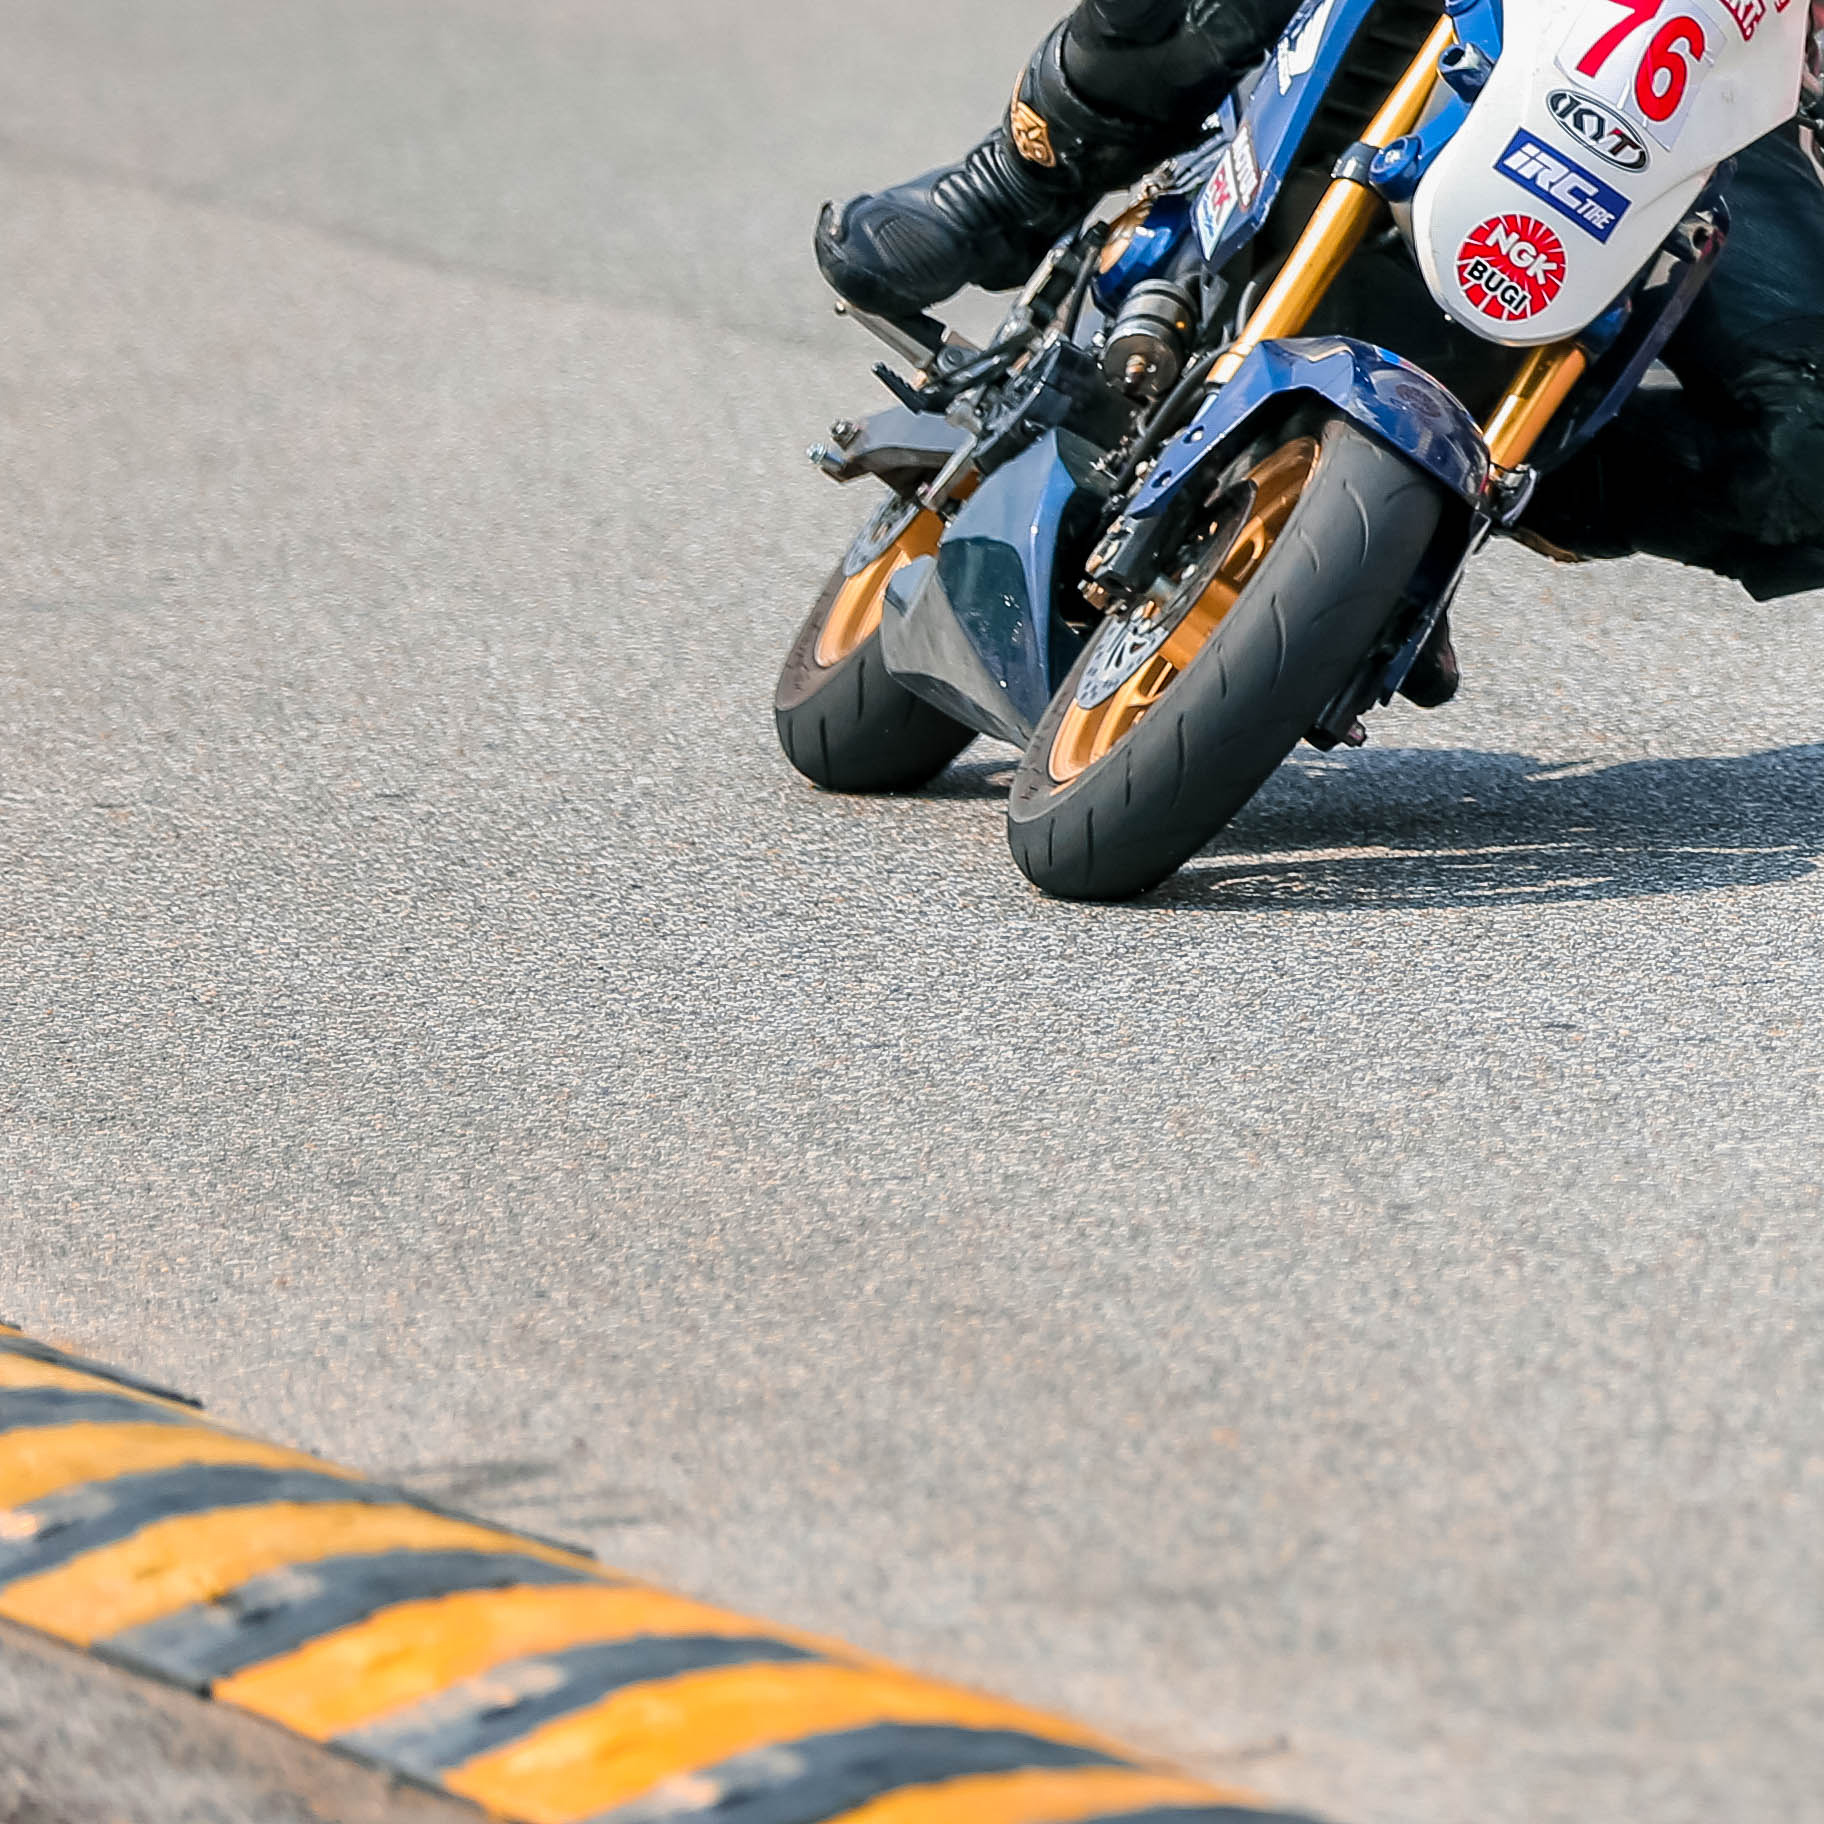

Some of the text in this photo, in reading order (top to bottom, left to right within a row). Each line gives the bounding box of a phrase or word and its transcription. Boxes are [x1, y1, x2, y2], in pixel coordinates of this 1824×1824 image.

[1556, 94, 1645, 162] KYT
[1576, 196, 1618, 231] TIRE
[1484, 222, 1558, 286] NGK
[1468, 258, 1530, 314] BUGI
